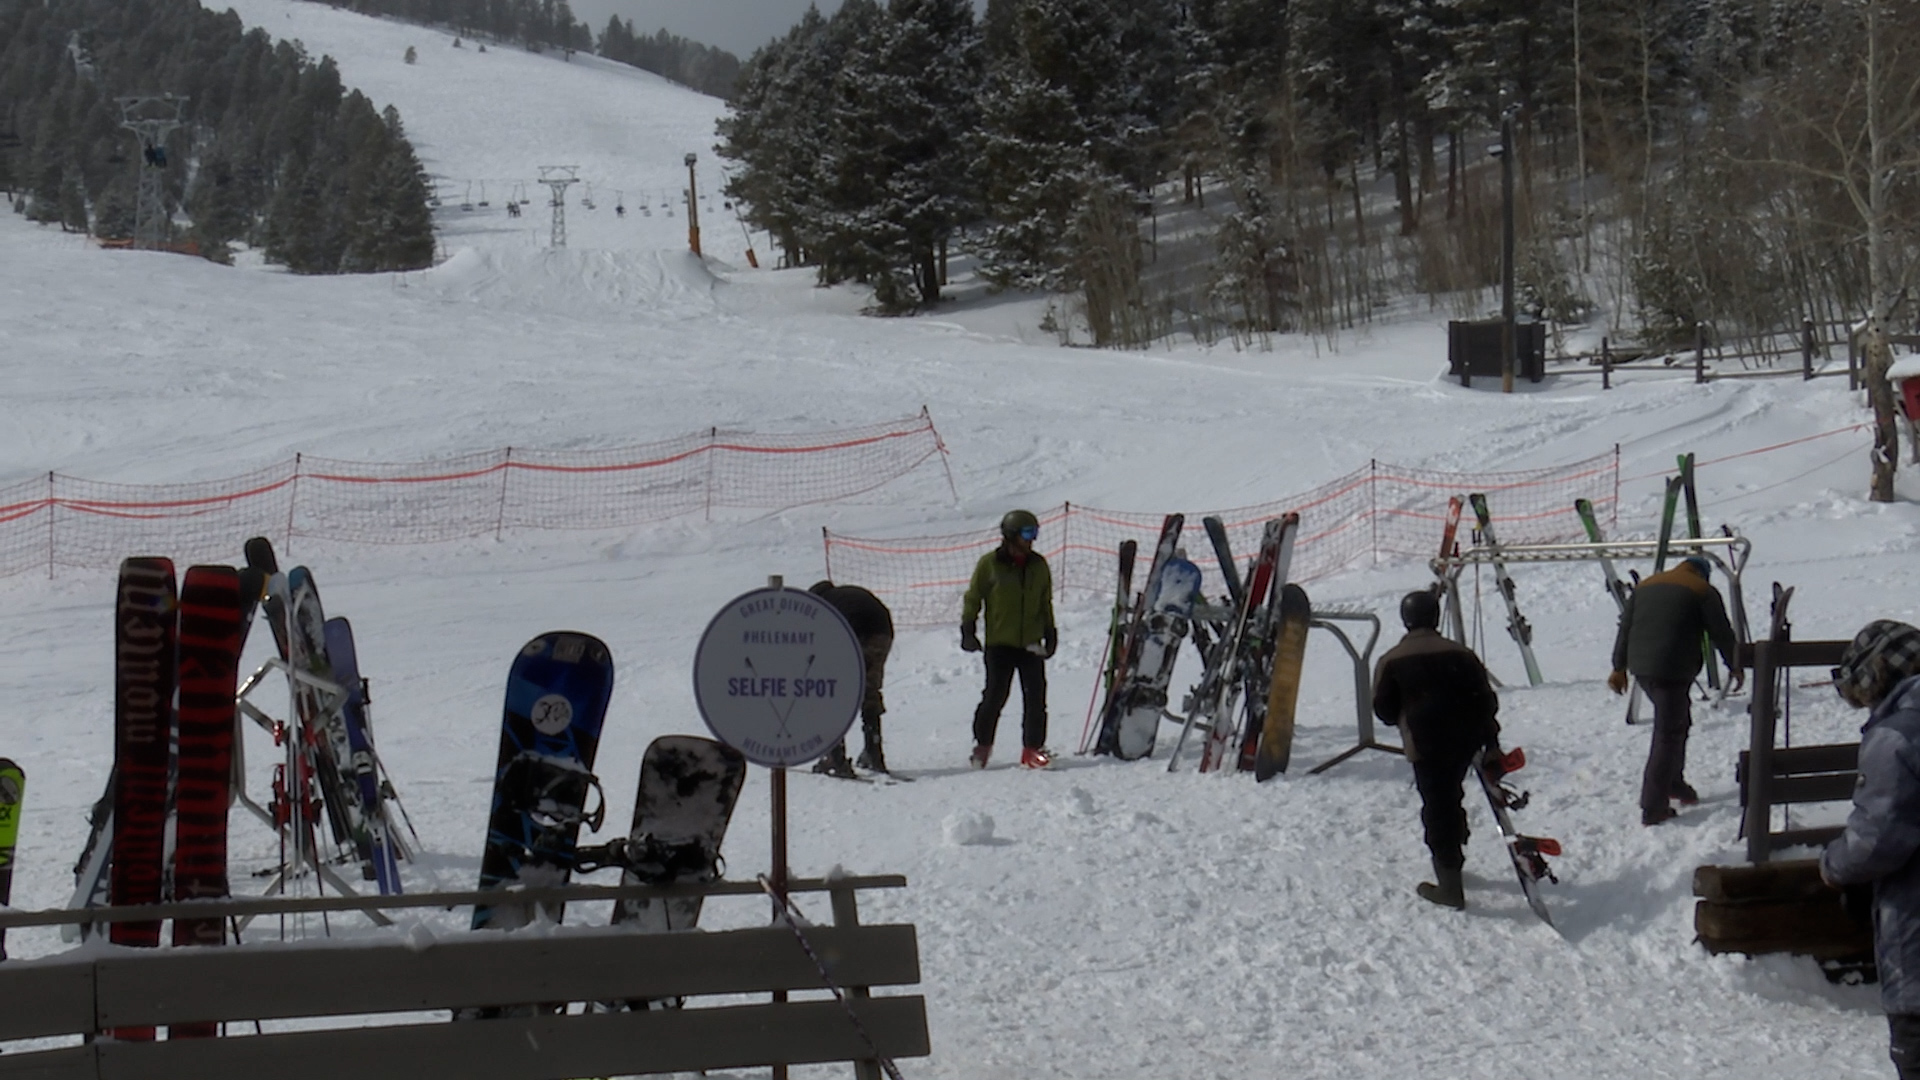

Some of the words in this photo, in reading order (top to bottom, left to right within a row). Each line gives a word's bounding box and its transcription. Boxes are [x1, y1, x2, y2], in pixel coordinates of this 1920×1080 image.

[740, 597, 775, 618] GREAT
[780, 597, 818, 620] DIVIDE
[743, 630, 815, 645] #HELENAMT
[728, 677, 787, 698] SELFIE
[793, 678, 838, 698] SPOT
